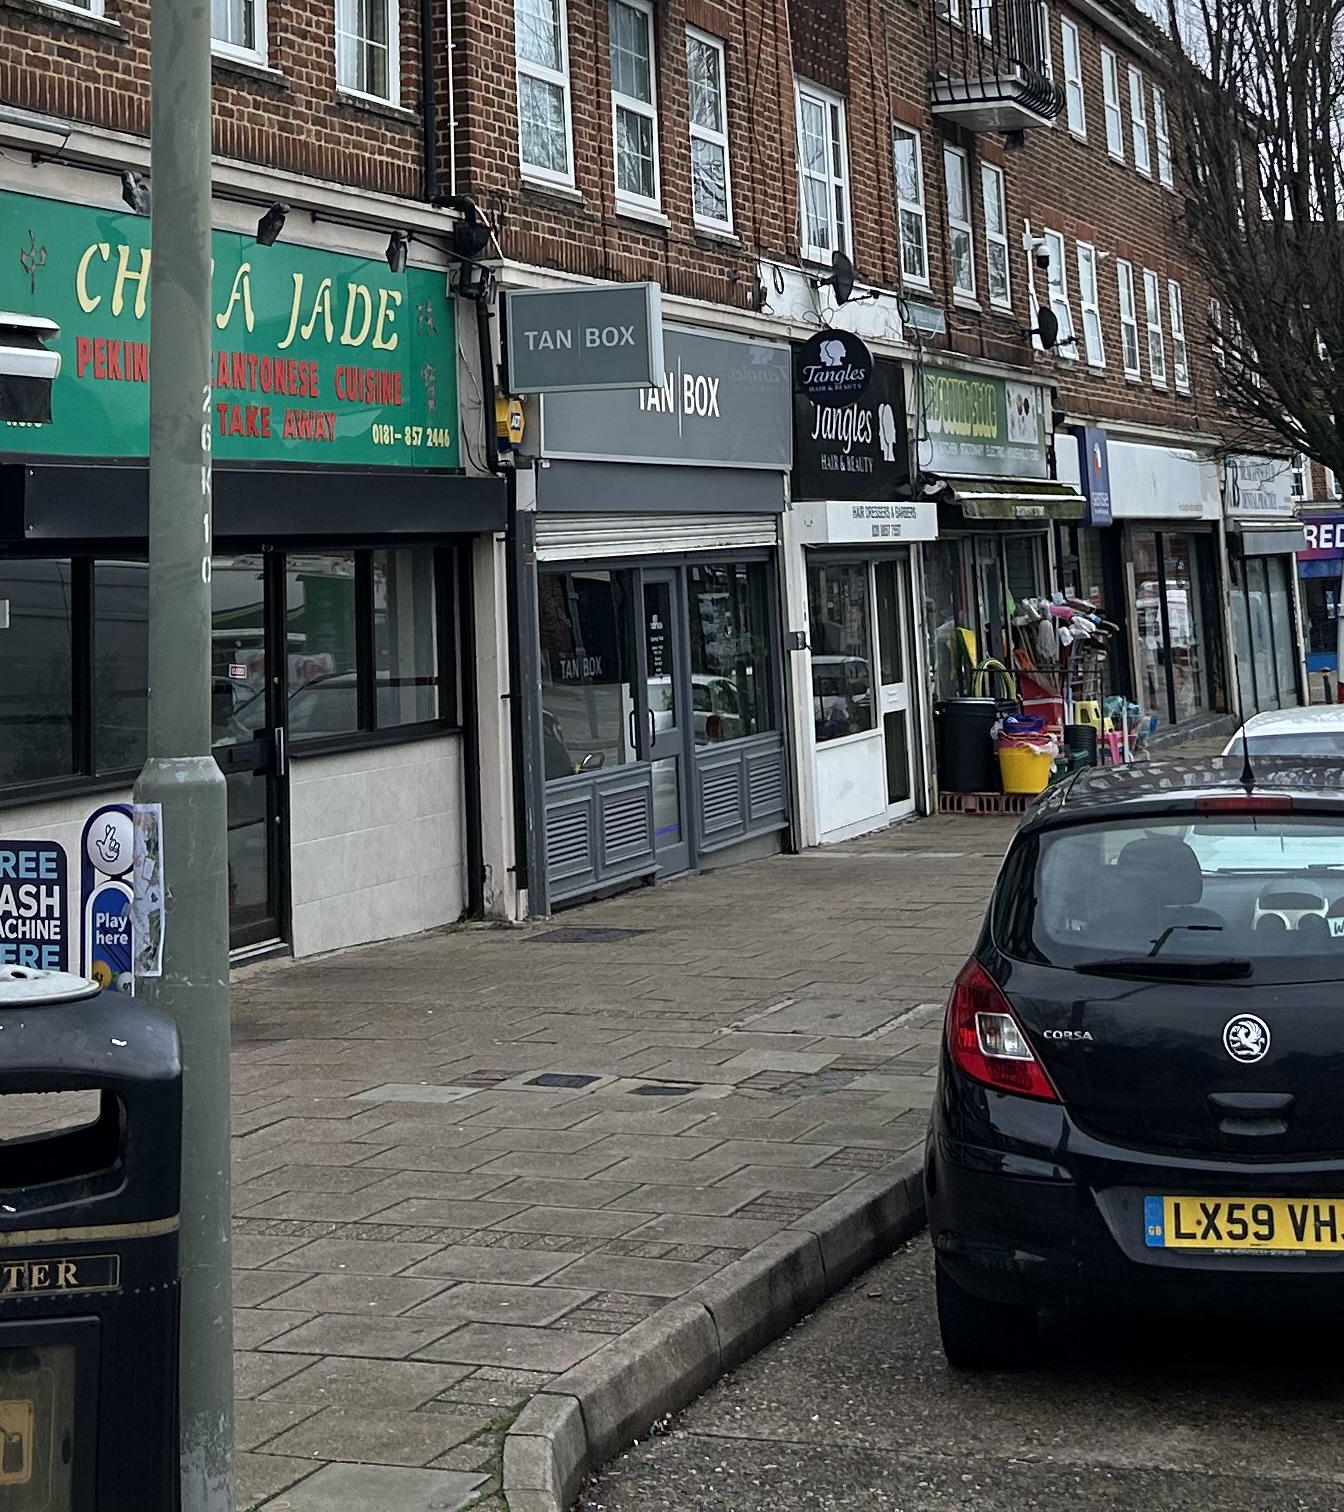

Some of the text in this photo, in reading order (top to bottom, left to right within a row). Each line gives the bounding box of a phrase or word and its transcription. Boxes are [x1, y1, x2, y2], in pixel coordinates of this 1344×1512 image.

[76, 242, 256, 334] CHA
[278, 272, 403, 352] JADE
[524, 325, 636, 351] TAN BOX
[76, 336, 149, 383] PEKIN
[211, 351, 319, 399] ANTONESE
[334, 364, 403, 407] CUISINE
[803, 363, 866, 385] Tangles
[684, 373, 720, 418] BOX
[216, 402, 337, 443] TAKE AWAY
[405, 426, 423, 447] 857
[427, 427, 450, 448] 2446
[847, 455, 874, 473] BEAUTY
[560, 656, 603, 680] TAN BOX
[96, 912, 128, 932] Play
[96, 930, 129, 945] here
[1043, 1030, 1093, 1040] CORSA
[1148, 1226, 1162, 1236] GB
[1174, 1202, 1274, 1241] LX59
